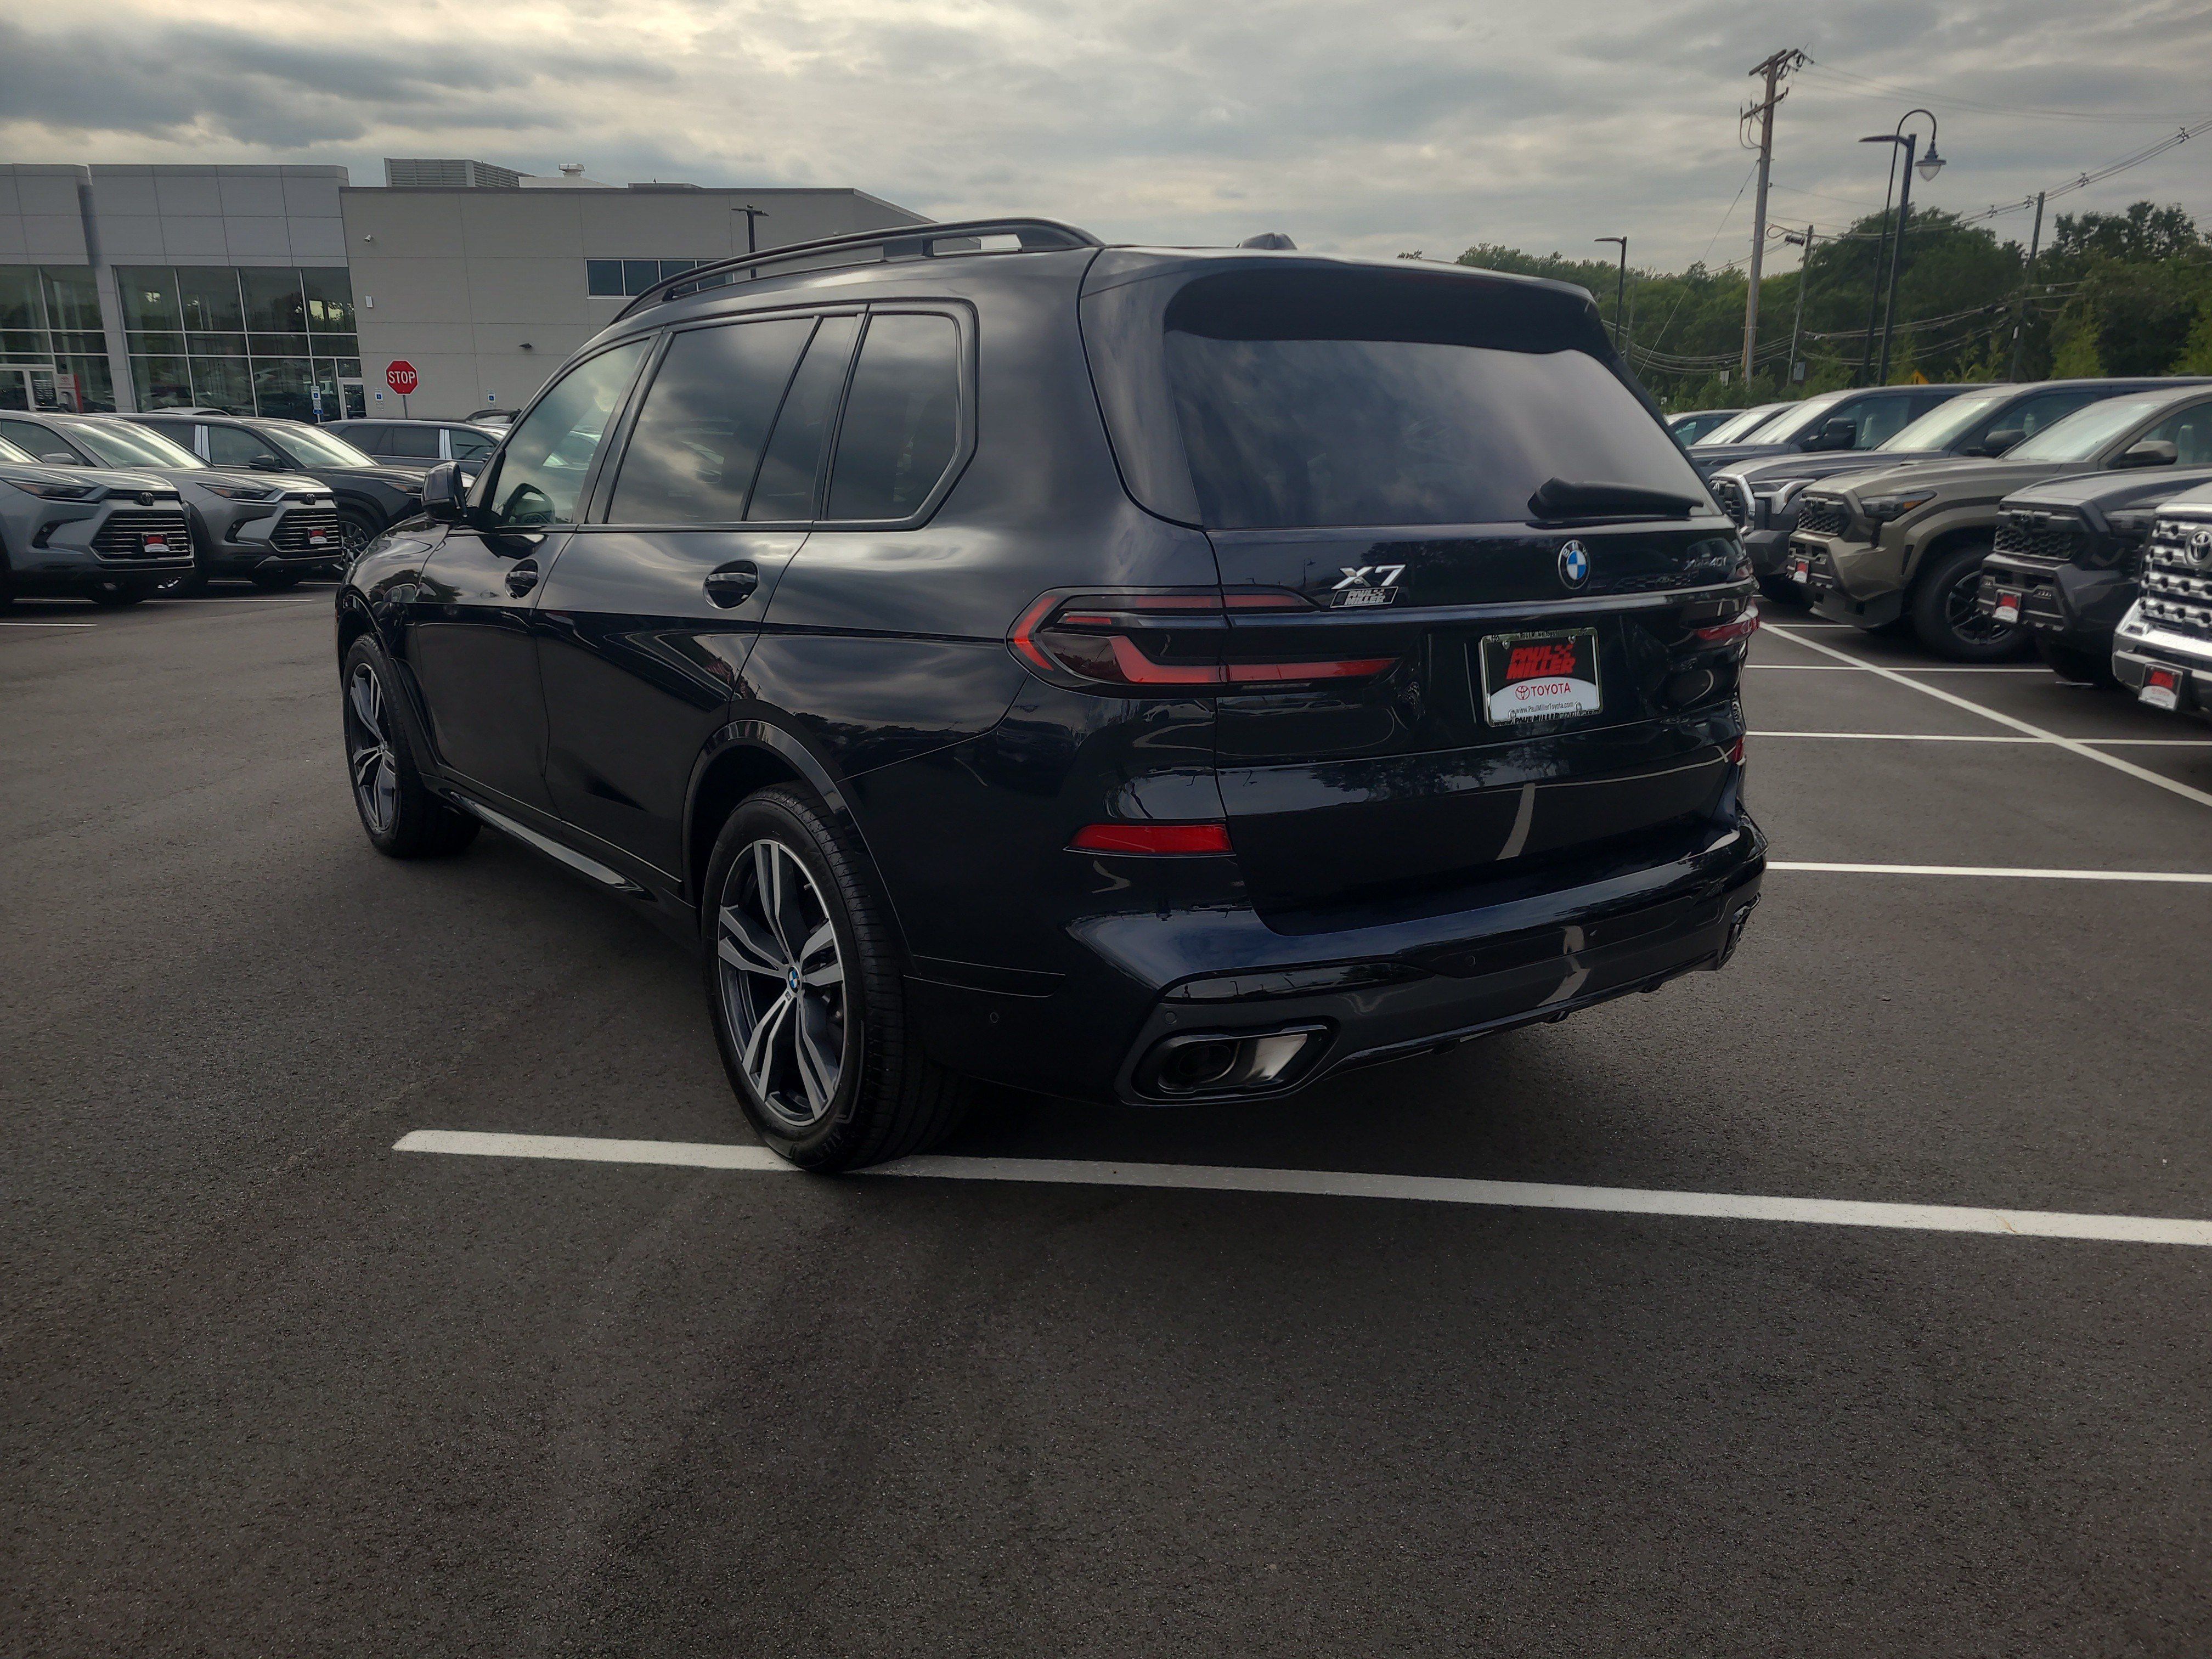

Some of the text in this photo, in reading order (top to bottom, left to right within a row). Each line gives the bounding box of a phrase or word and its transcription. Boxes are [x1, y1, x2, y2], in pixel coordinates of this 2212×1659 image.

[388, 371, 415, 384] STOP
[1330, 564, 1406, 590] X7
[1344, 595, 1385, 606] MILLER
[1511, 645, 1560, 665] PAUL
[1506, 657, 1576, 680] MILLER
[1531, 682, 1571, 697] TOYOTA
[1515, 702, 1573, 714] www.PaulMillerToyota.com
